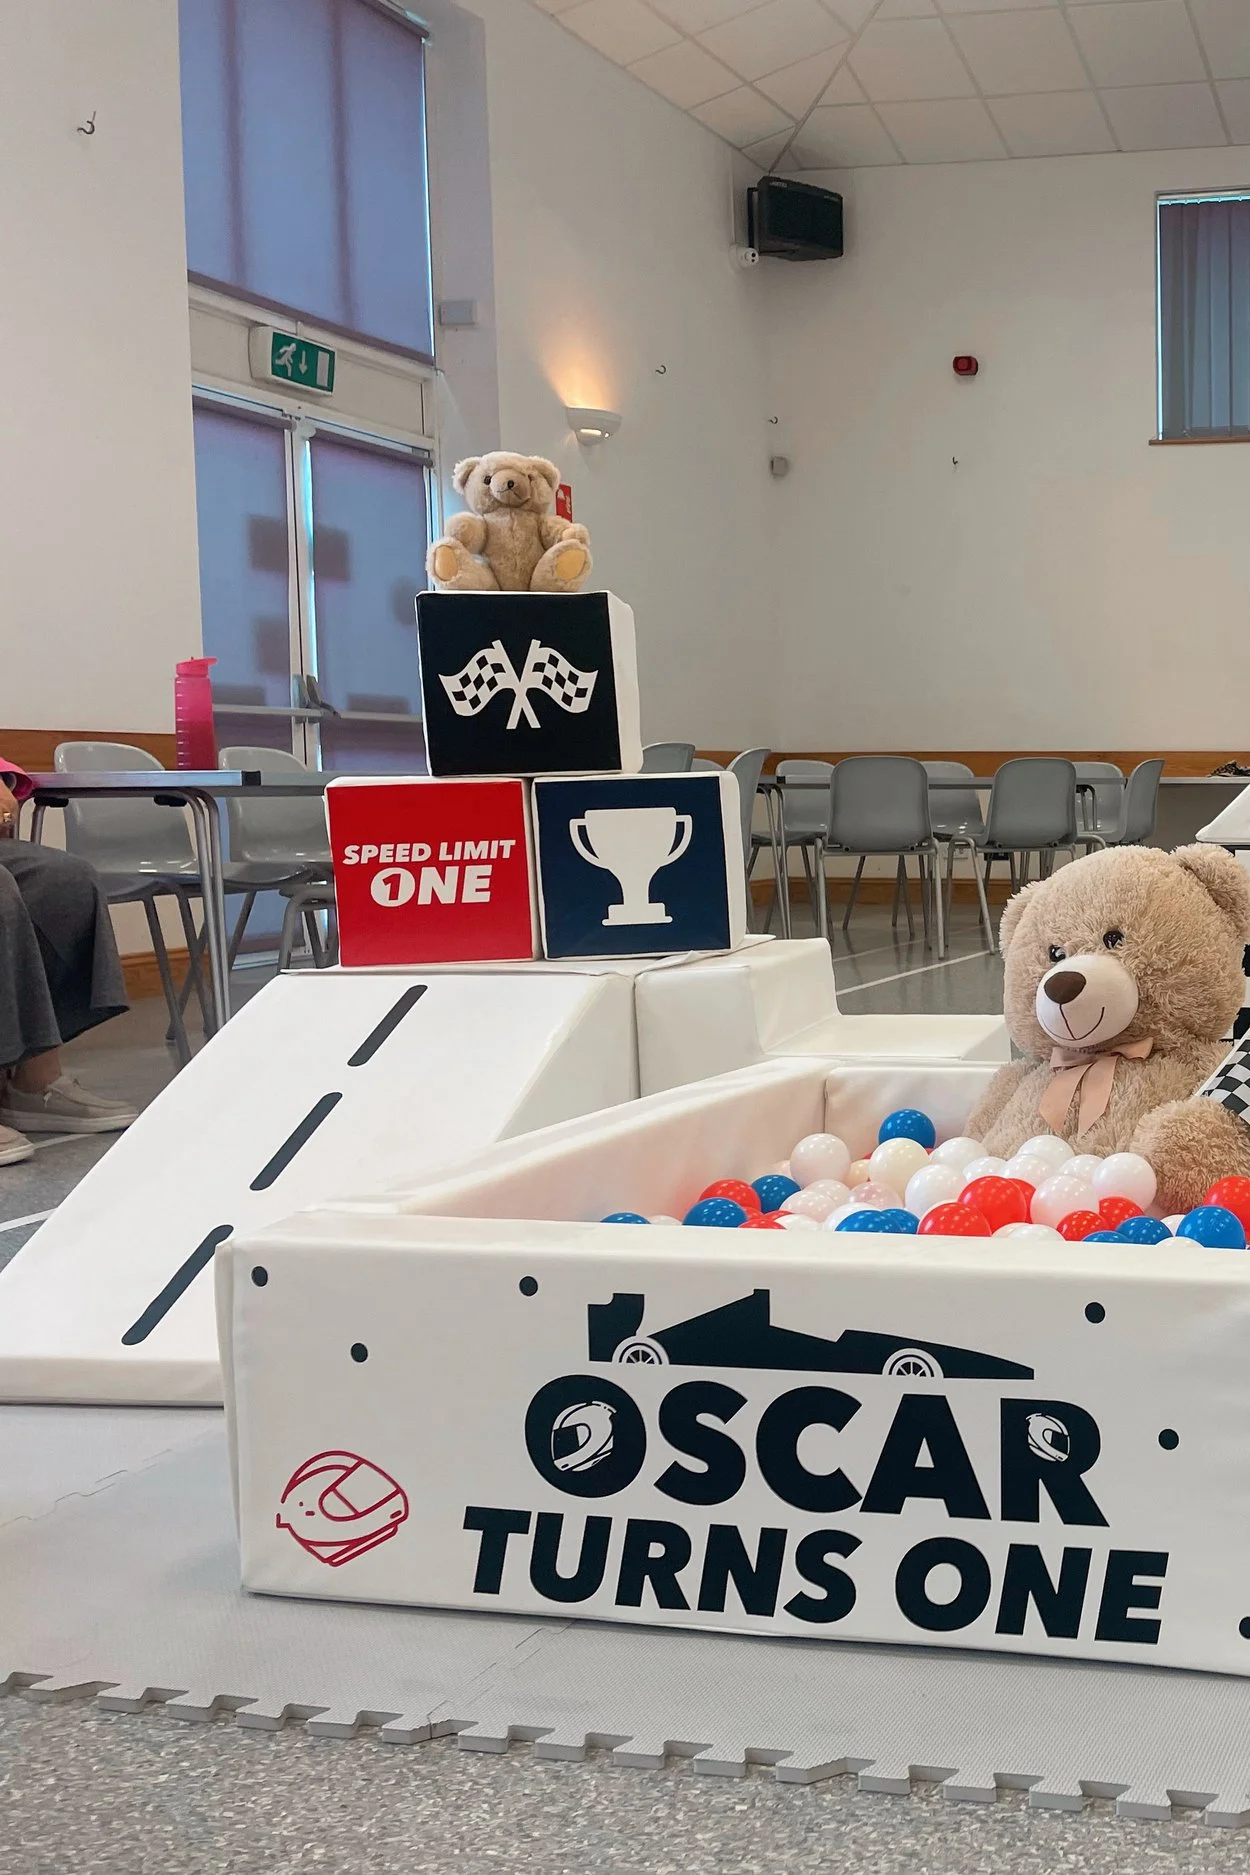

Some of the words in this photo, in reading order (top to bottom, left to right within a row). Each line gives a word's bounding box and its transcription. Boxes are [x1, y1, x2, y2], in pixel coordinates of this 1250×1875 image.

[342, 843, 432, 866] SPEED
[439, 839, 516, 861] LIMIT
[370, 865, 493, 908] ONE
[524, 1374, 1110, 1528] OSCAR
[463, 1506, 862, 1625] TURNS
[895, 1536, 1169, 1645] ONE
